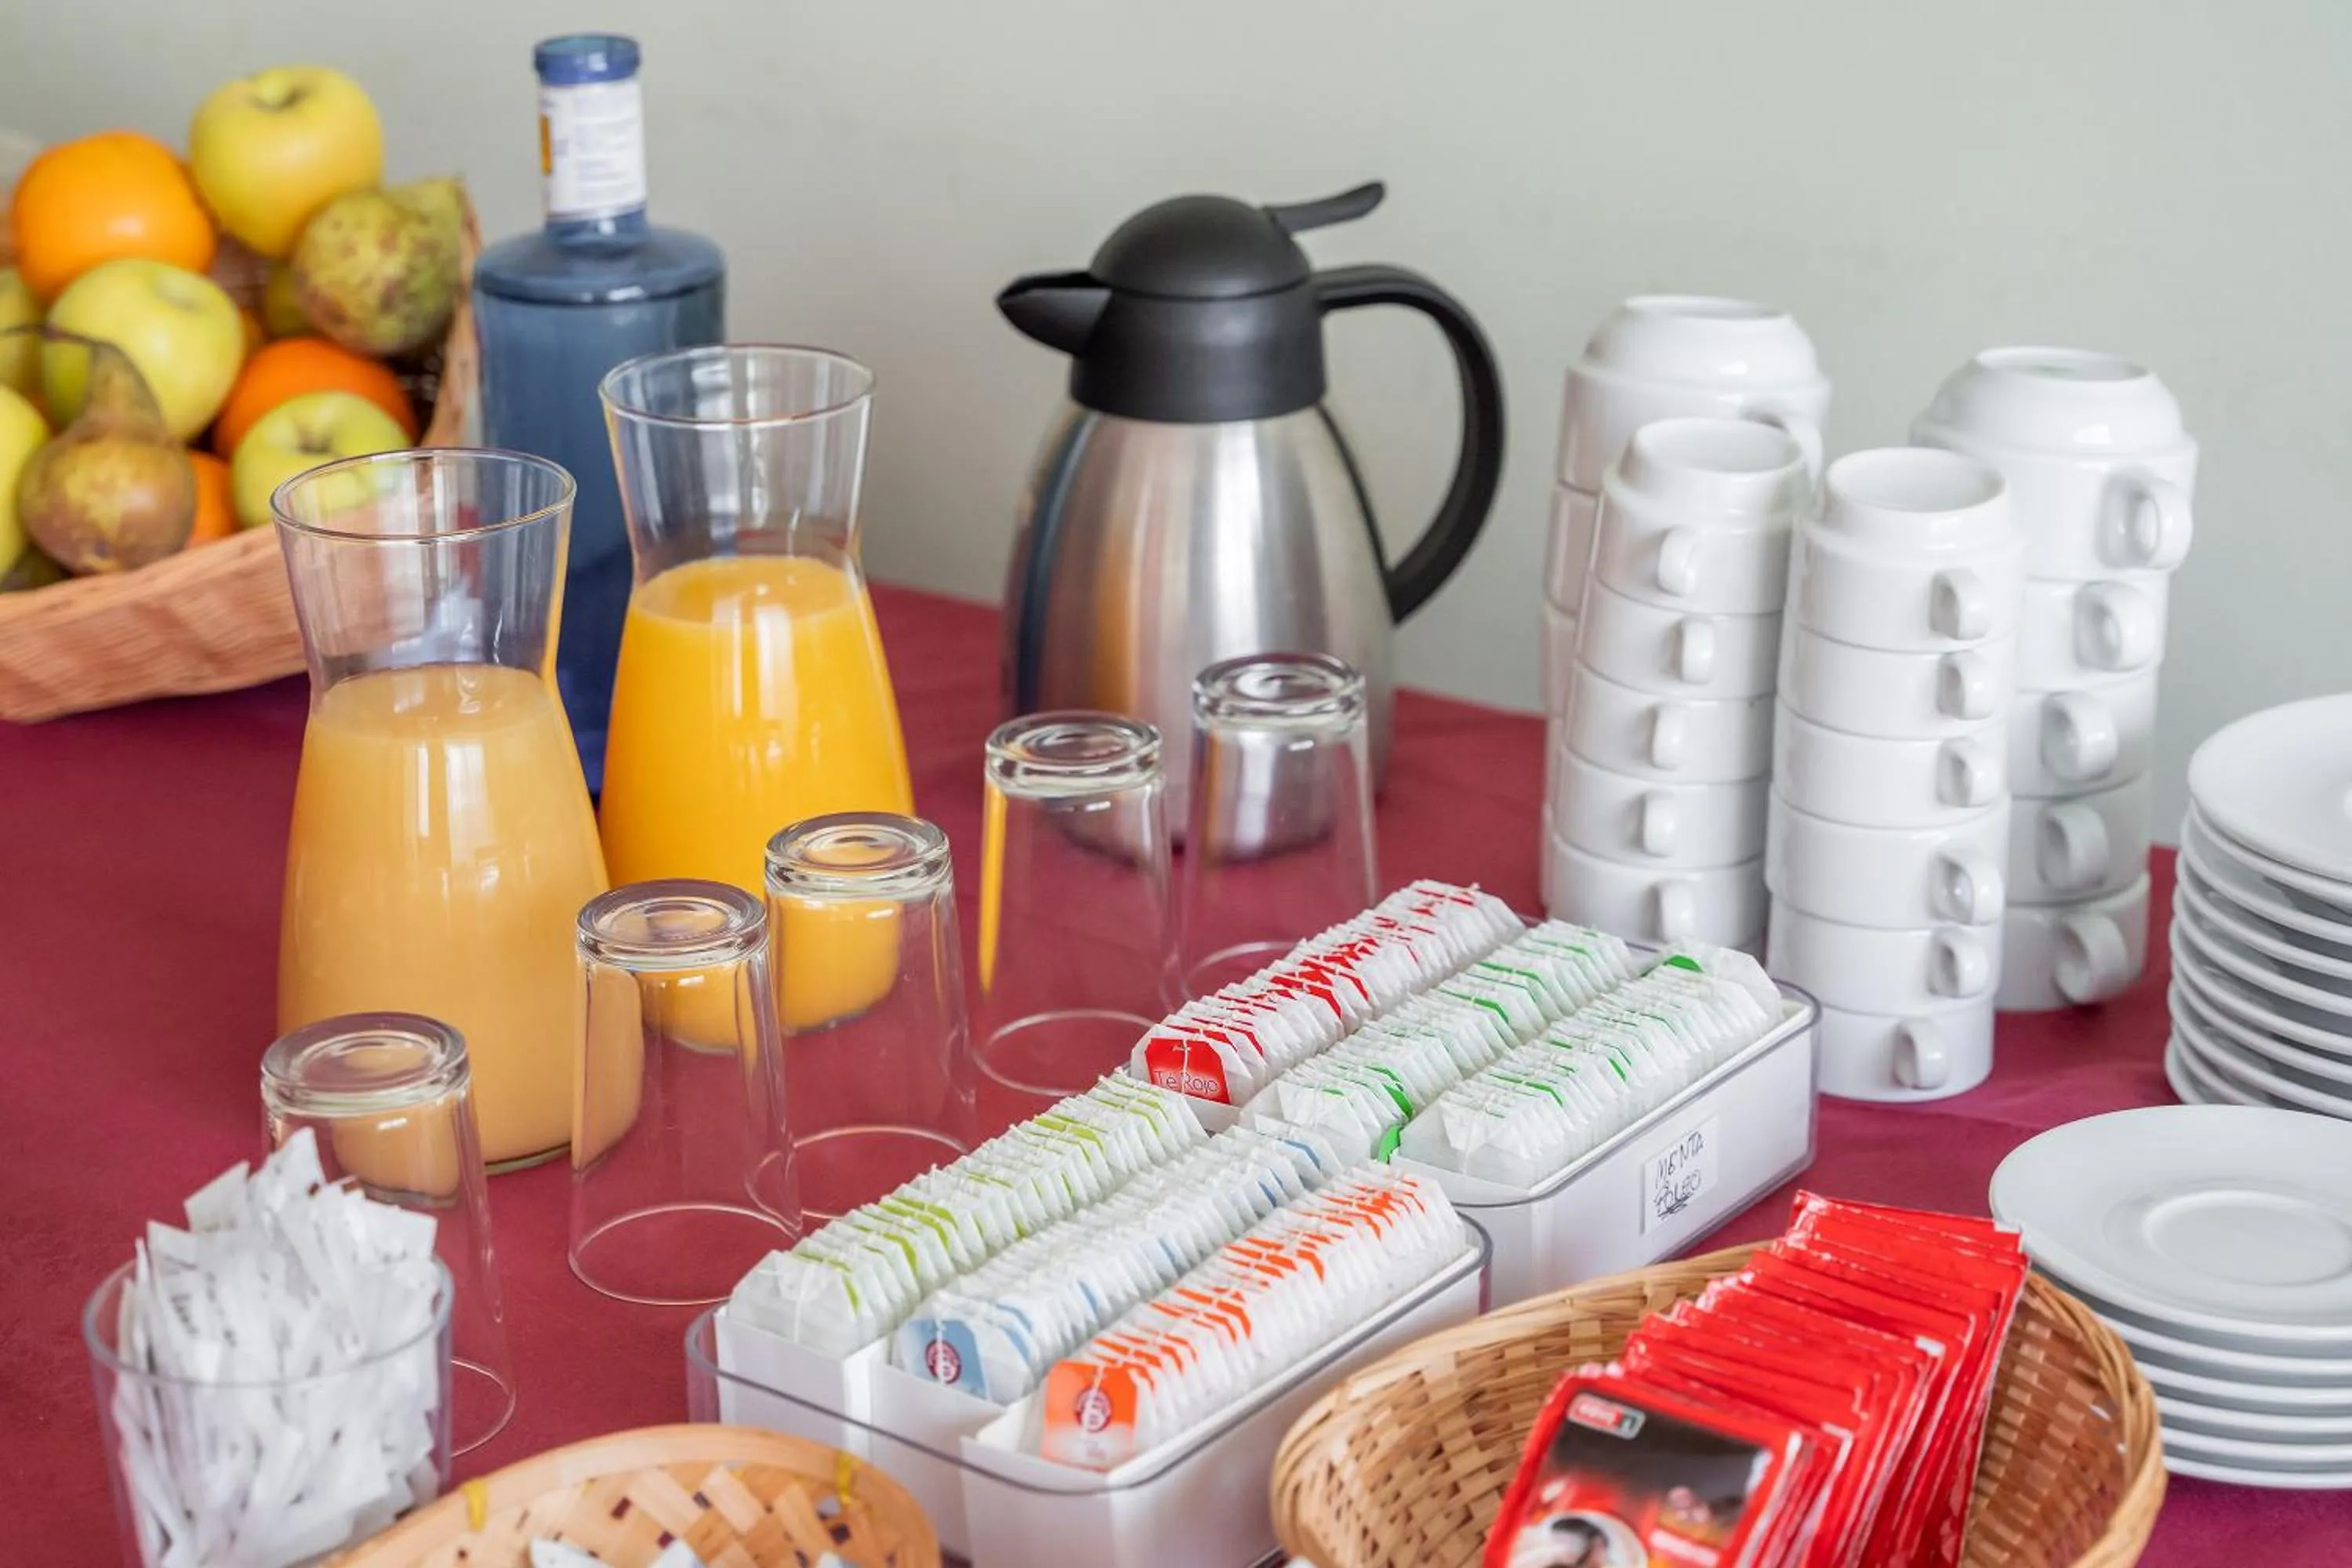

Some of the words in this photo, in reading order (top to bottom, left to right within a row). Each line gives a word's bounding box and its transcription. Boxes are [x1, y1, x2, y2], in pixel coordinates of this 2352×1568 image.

[1154, 1070, 1177, 1090] Té
[1181, 1072, 1218, 1094] Rojo
[1655, 1131, 1704, 1189] MENTA
